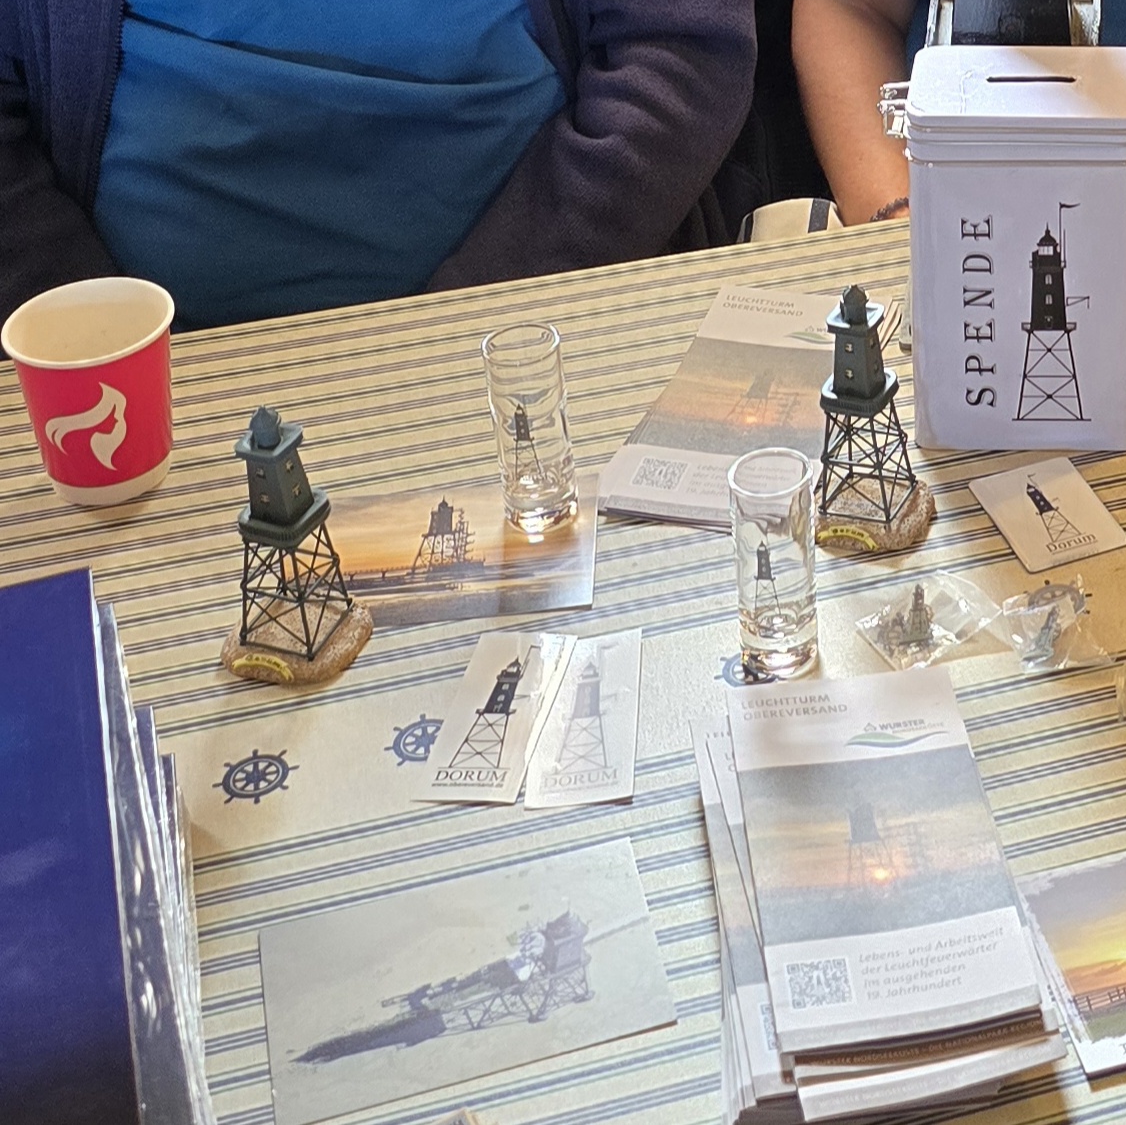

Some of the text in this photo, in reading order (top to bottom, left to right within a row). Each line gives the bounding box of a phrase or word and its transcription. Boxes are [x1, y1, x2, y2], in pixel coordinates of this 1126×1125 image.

[722, 302, 804, 317] OBEREVERSAND
[726, 294, 795, 309] LEUCHTTURM
[961, 215, 997, 408] SPENDE
[1046, 534, 1096, 553] Dorum
[741, 693, 831, 710] LEUCHTTURM
[743, 704, 848, 722] OBEREVERSAND
[879, 719, 926, 730] WURSTER
[435, 770, 508, 782] DORUM
[544, 768, 618, 788] DORUM
[908, 943, 932, 955] und
[934, 927, 1004, 951] Arbeitswelt
[861, 965, 882, 975] der
[864, 962, 966, 988] im ausgehenden
[886, 976, 962, 998] Jahrhundert
